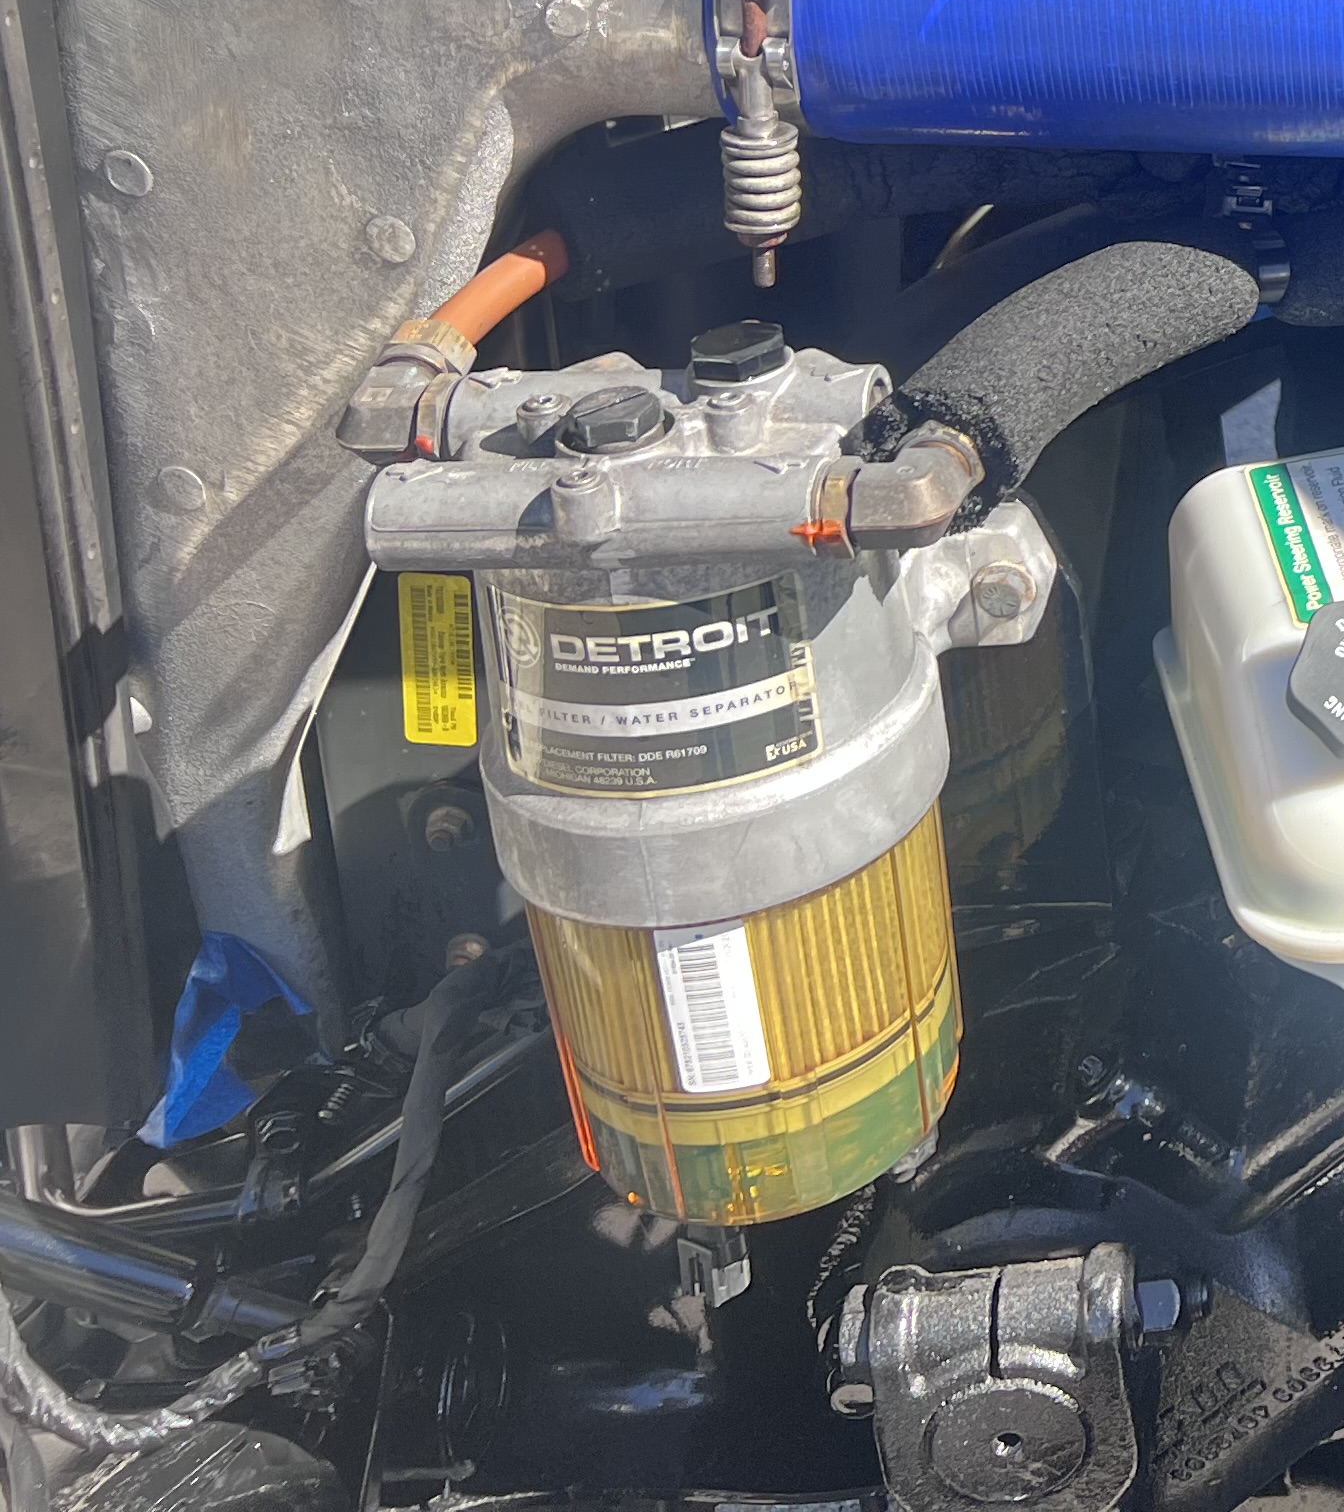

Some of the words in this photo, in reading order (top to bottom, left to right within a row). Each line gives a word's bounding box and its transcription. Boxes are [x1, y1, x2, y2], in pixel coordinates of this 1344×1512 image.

[1263, 473, 1296, 526] Reservoir
[1283, 525, 1312, 574] Steering
[1300, 573, 1323, 611] Power
[549, 605, 778, 663] DETROIT
[554, 662, 600, 675] DEMAND
[539, 707, 592, 726] FILTER
[615, 710, 679, 726] WATER
[689, 679, 799, 718] SEPARATOR
[638, 750, 664, 763] DDE
[665, 744, 708, 760] R61709
[780, 738, 808, 755] USA
[575, 765, 651, 777] CORPORATION
